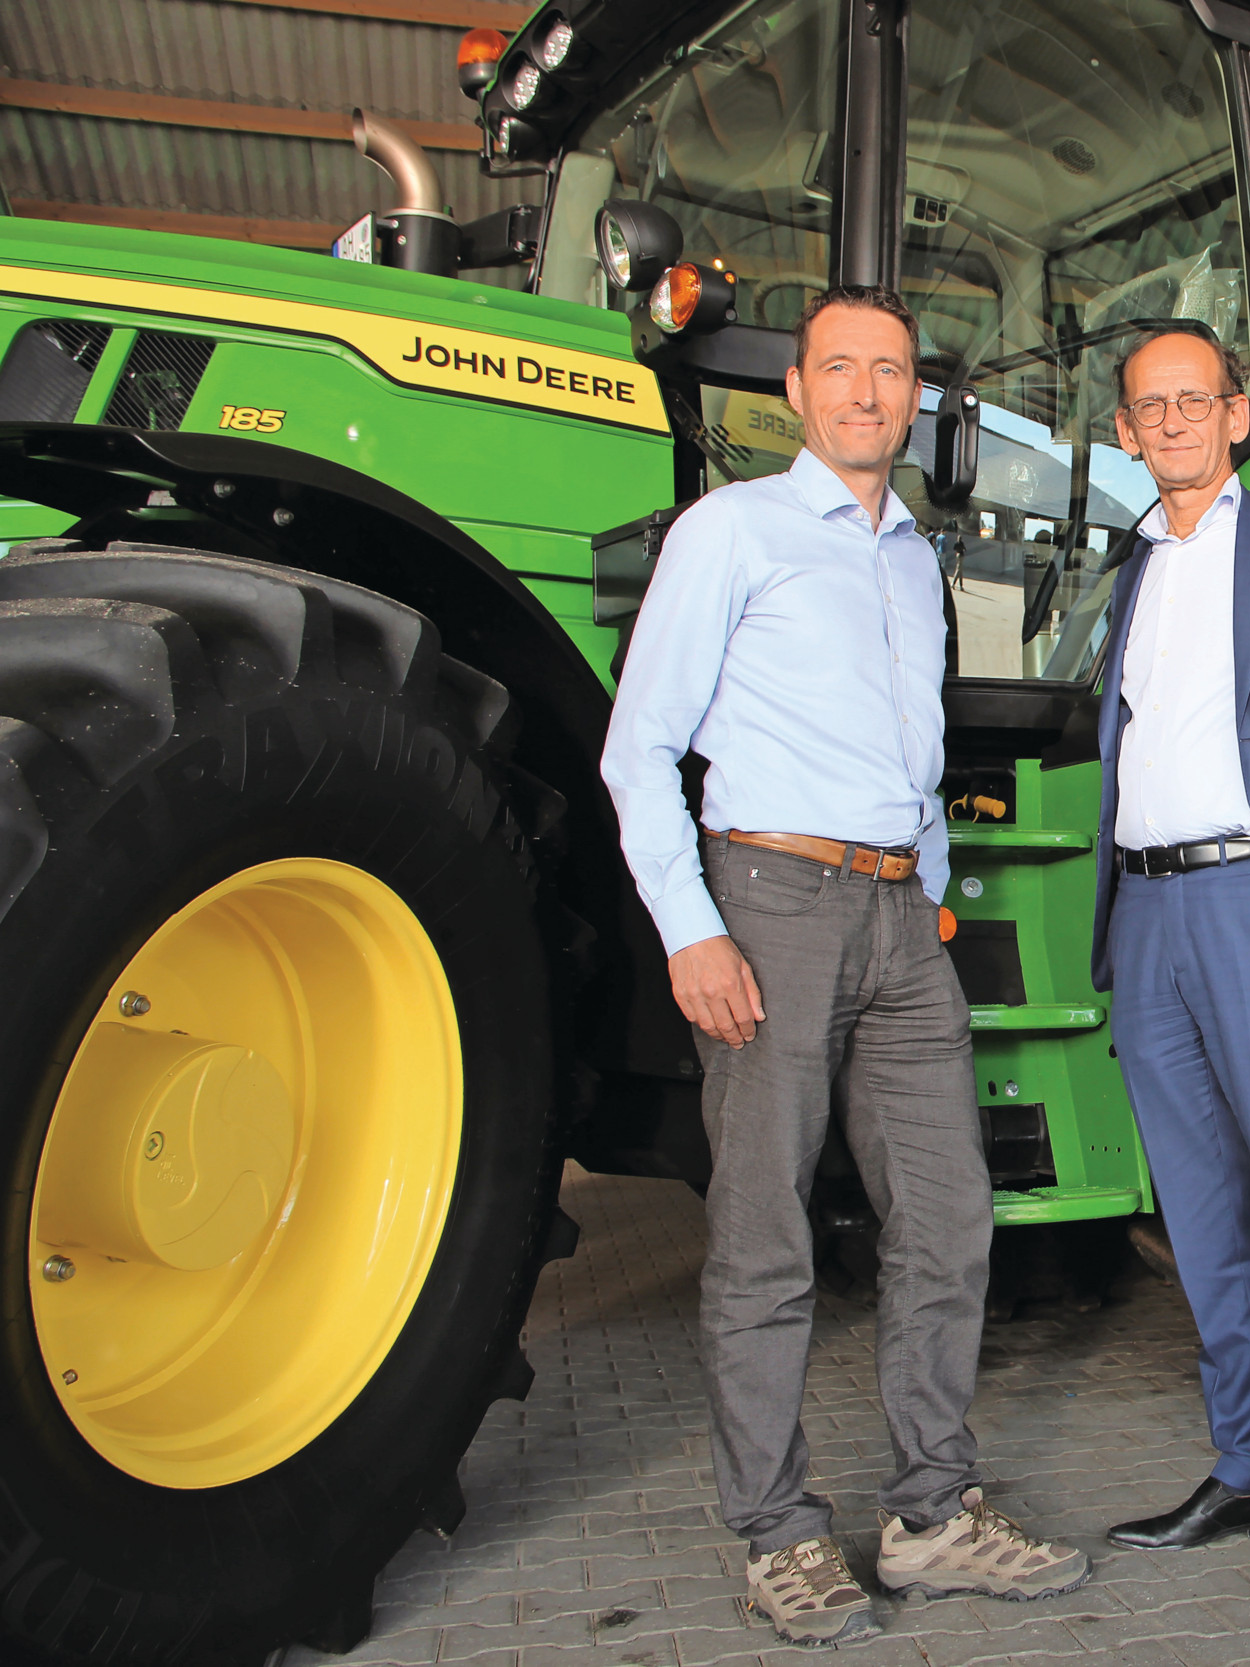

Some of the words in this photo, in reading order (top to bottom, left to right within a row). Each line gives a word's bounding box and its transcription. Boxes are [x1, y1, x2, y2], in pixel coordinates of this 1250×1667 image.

[402, 336, 506, 379] JOHN
[517, 356, 636, 404] DEERE
[219, 404, 287, 434] 185
